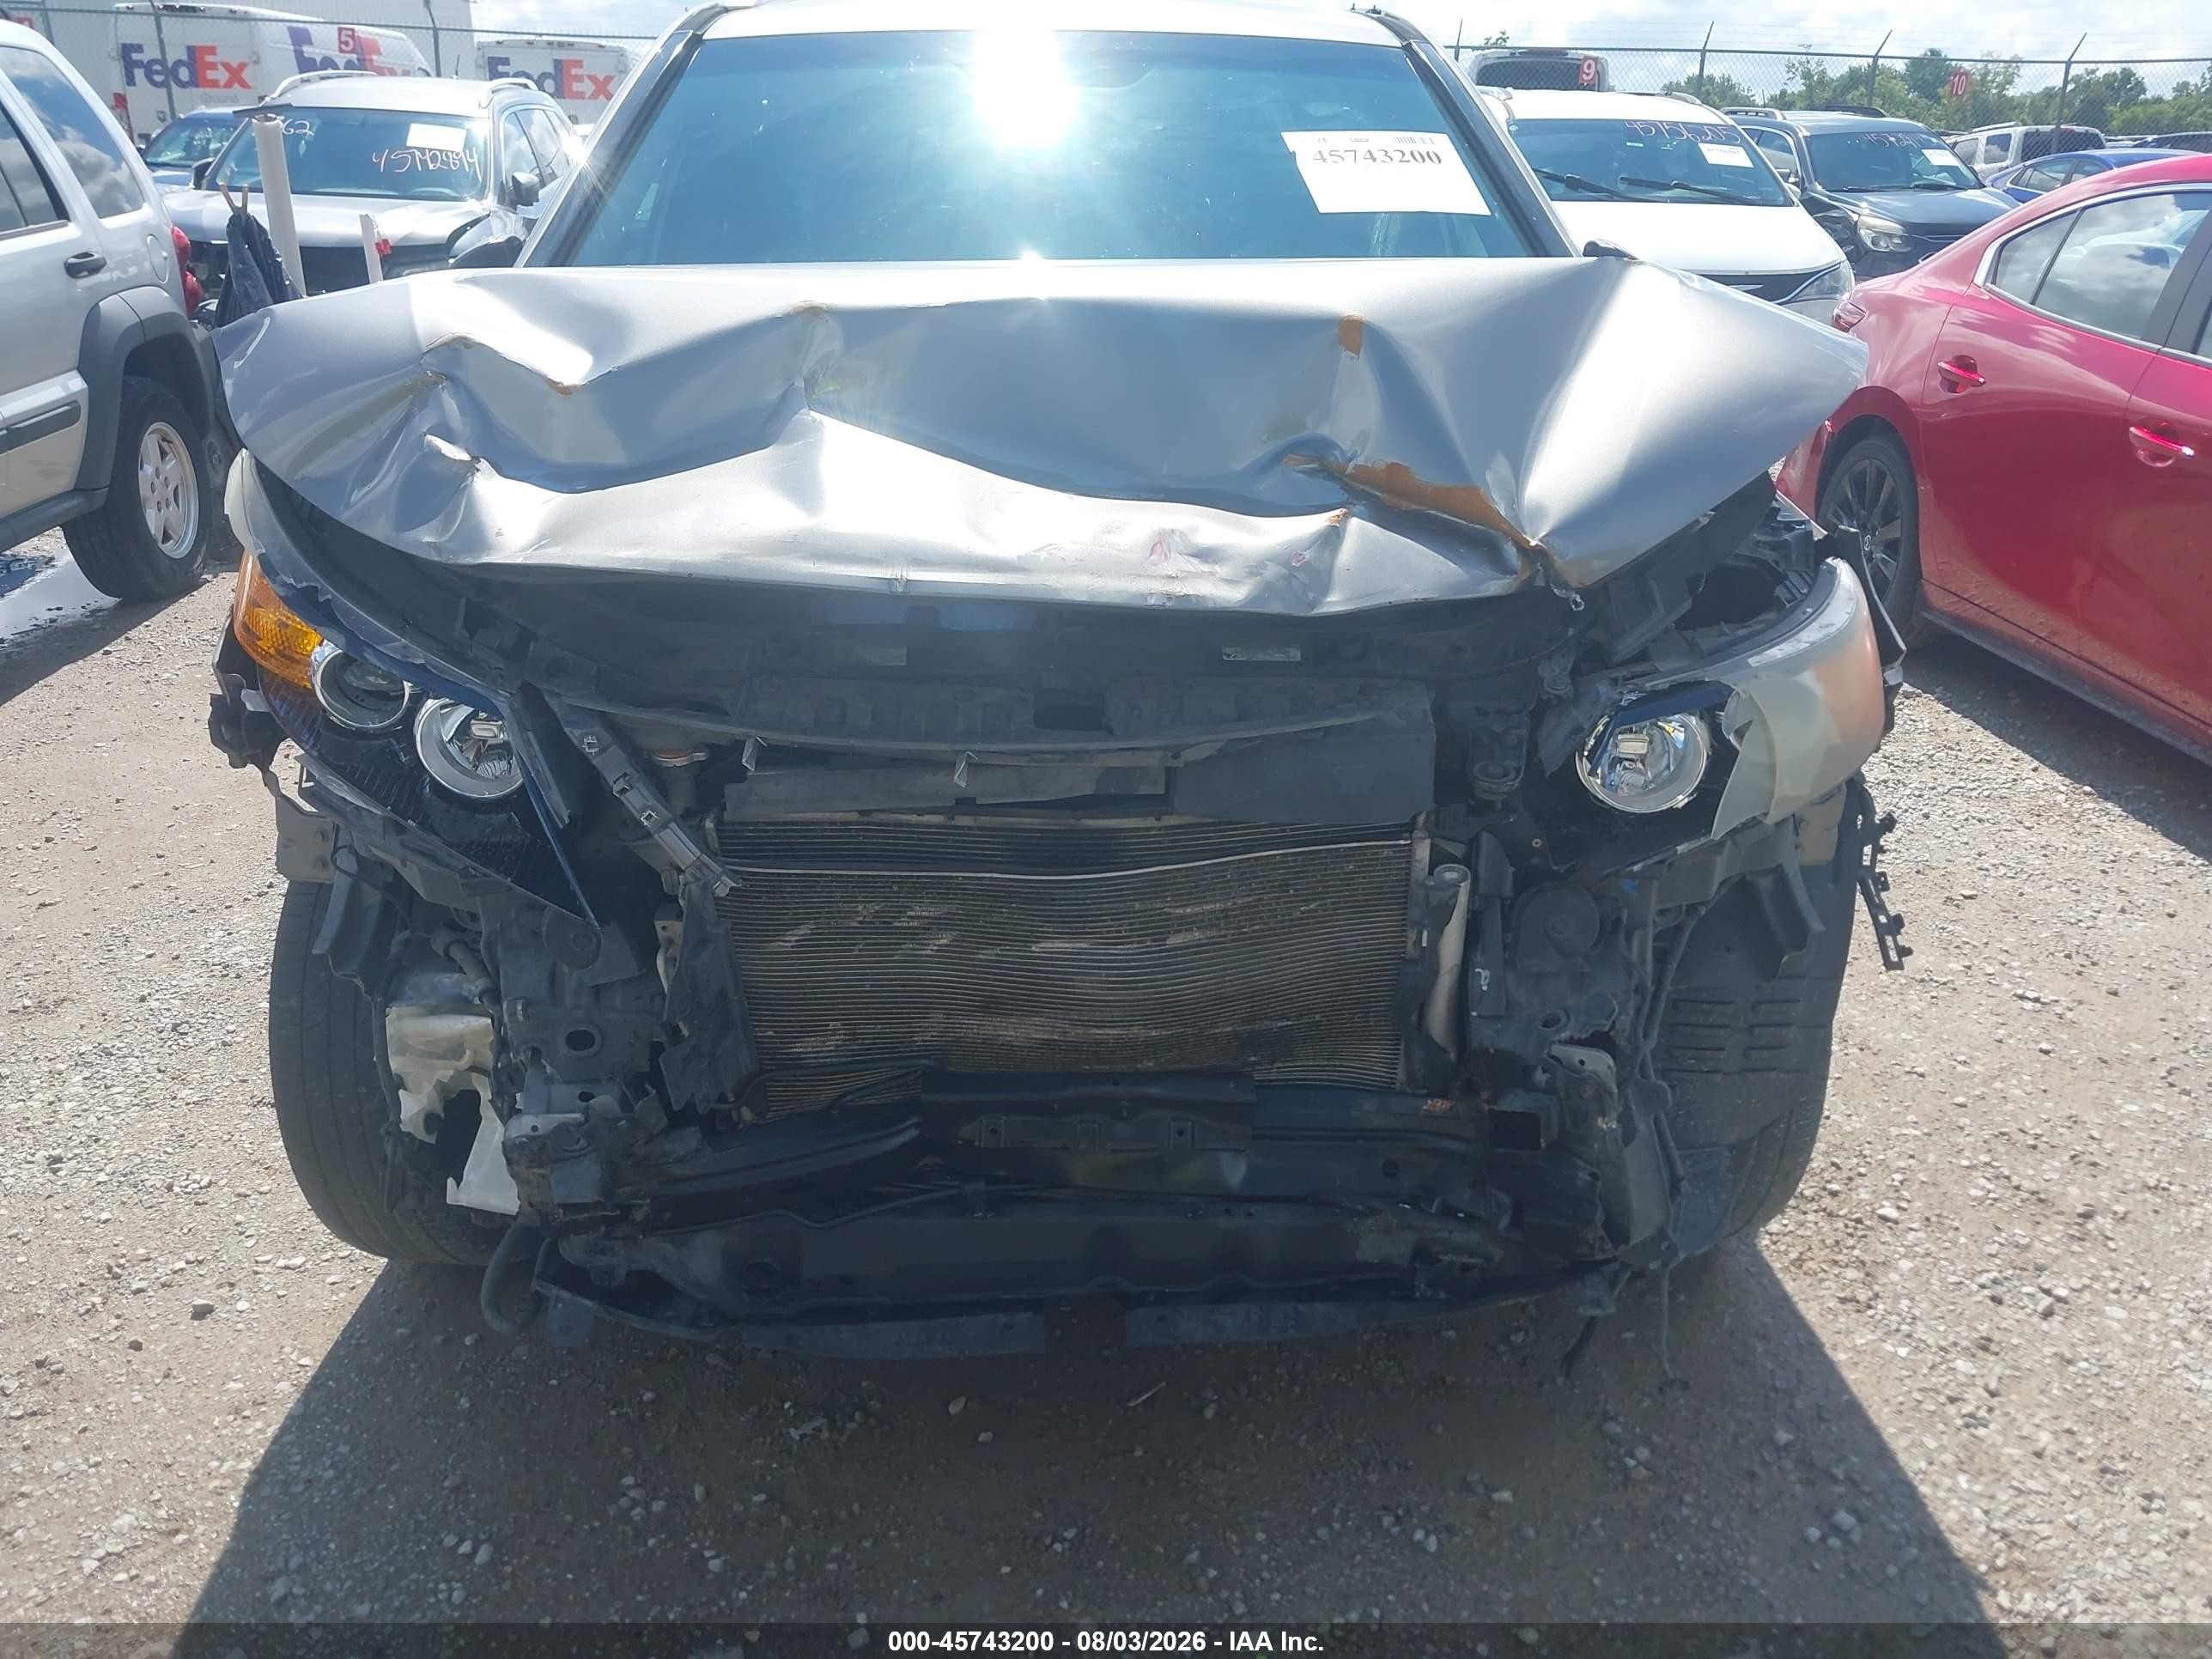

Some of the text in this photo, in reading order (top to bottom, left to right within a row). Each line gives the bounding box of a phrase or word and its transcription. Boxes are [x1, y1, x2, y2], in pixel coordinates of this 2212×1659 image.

[340, 30, 355, 52] 5
[121, 43, 252, 89] FedEx
[1582, 59, 1595, 81] 9
[1951, 74, 1966, 95] 10
[1312, 149, 1443, 165] 45743200
